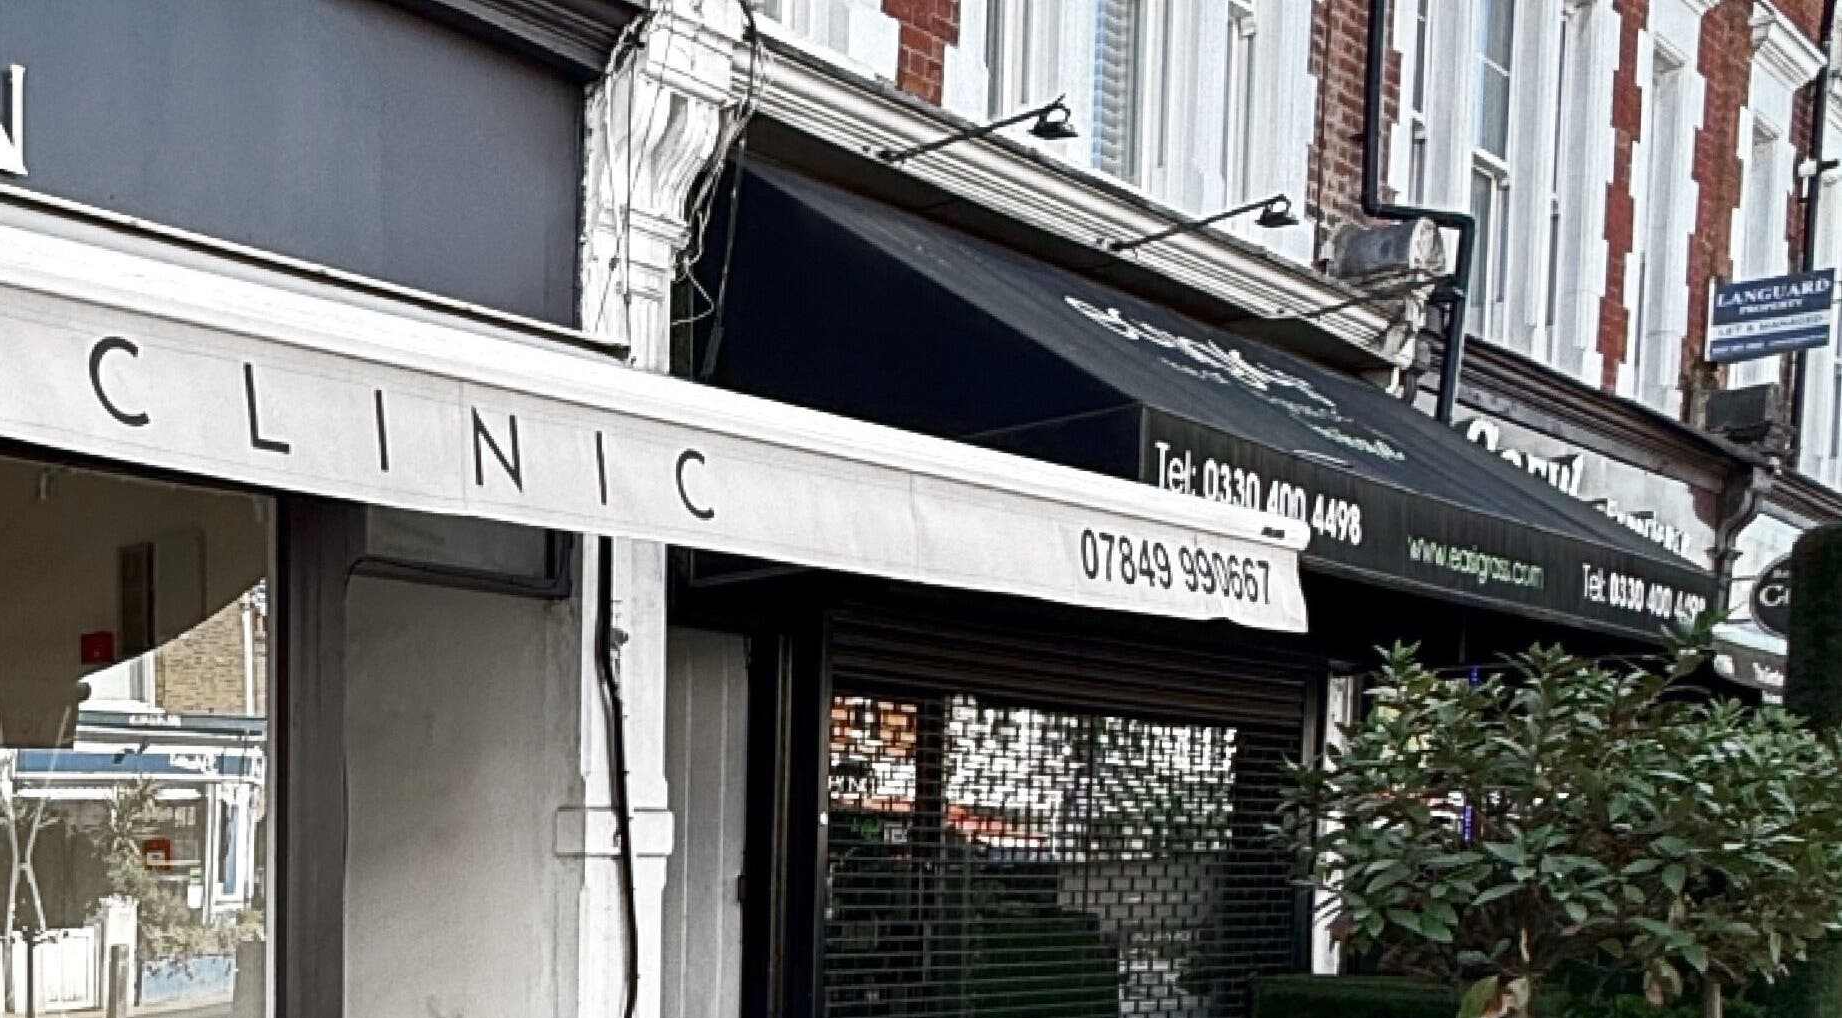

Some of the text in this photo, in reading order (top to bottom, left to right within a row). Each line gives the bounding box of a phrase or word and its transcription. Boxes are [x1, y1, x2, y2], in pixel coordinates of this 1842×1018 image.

[1716, 277, 1832, 308] LANGUARD
[88, 335, 715, 520] CLINIC
[1155, 440, 1363, 546] Tel: 0330 400 4498
[1080, 527, 1272, 605] 07849 990667
